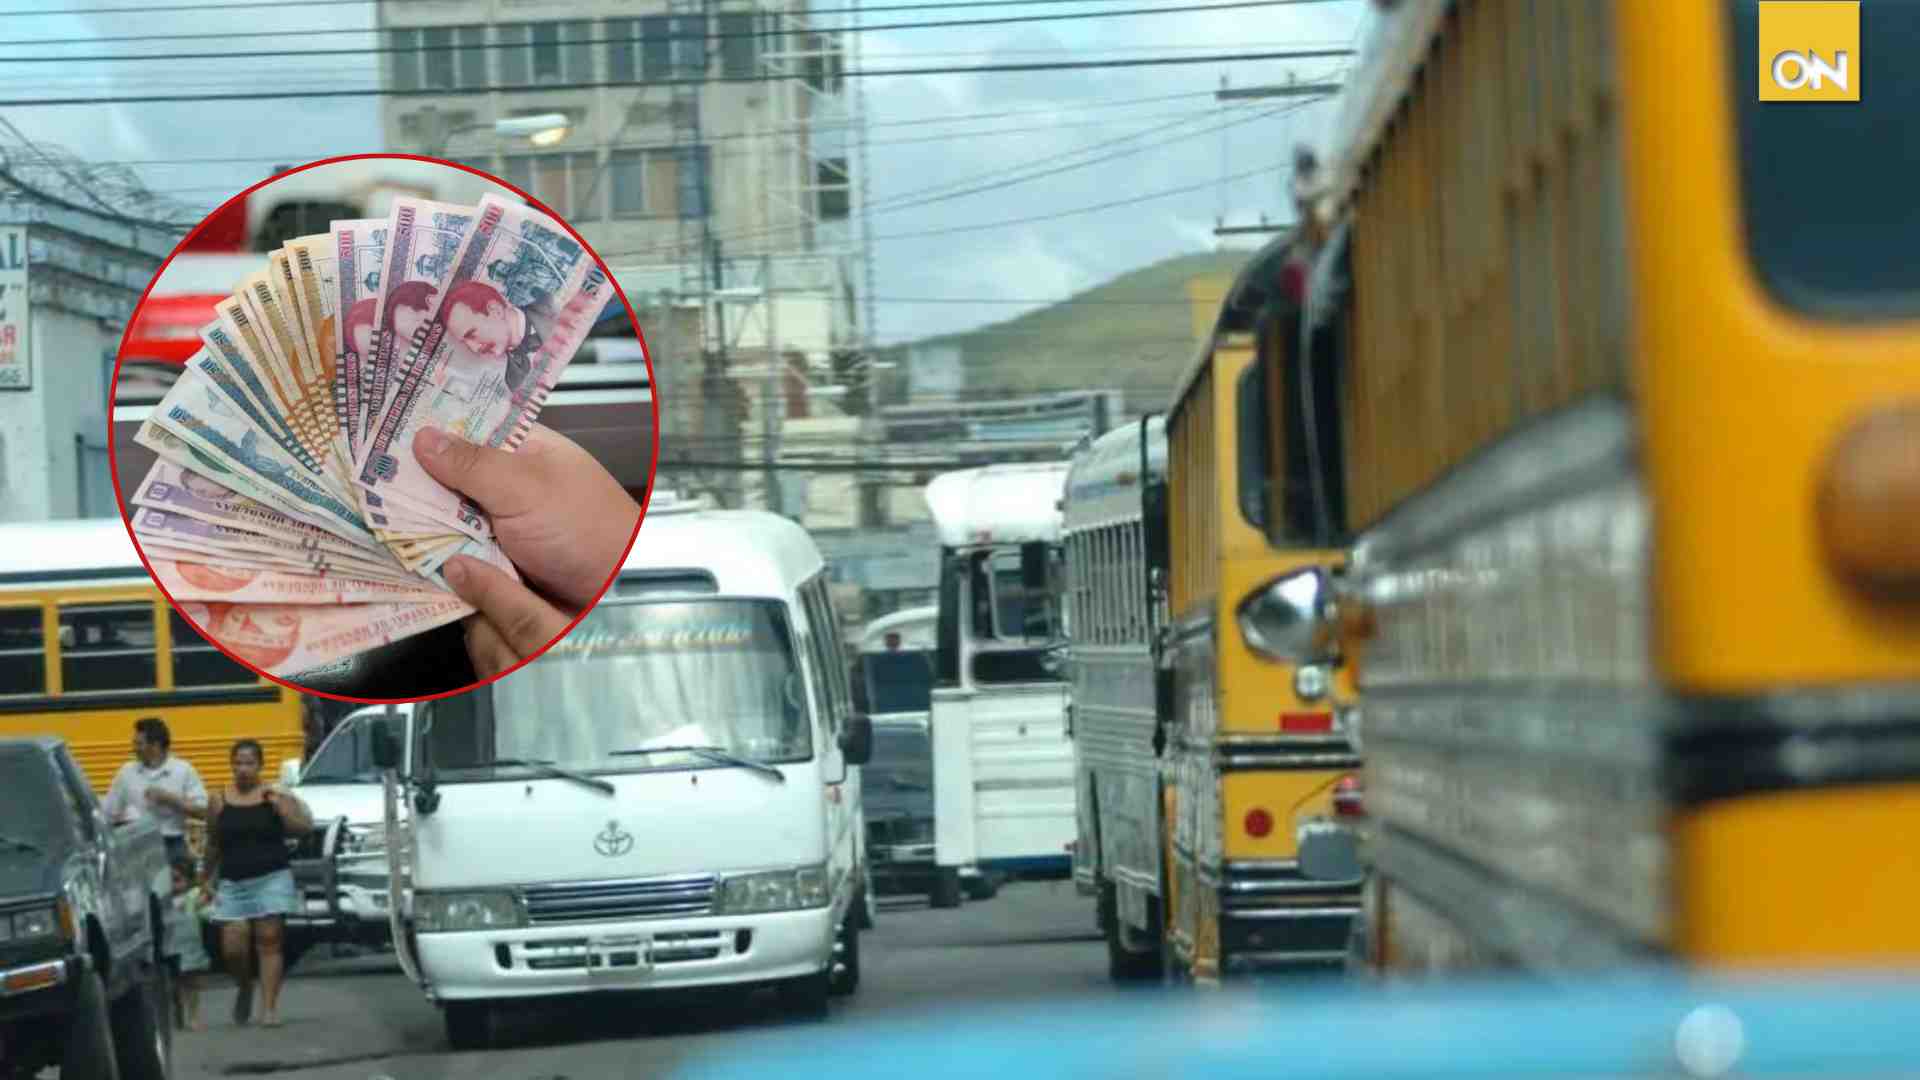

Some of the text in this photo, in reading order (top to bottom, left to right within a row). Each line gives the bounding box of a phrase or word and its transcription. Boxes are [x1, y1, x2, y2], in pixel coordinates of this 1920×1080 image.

[398, 206, 416, 237] 500
[479, 203, 503, 236] 500
[340, 231, 353, 256] 500
